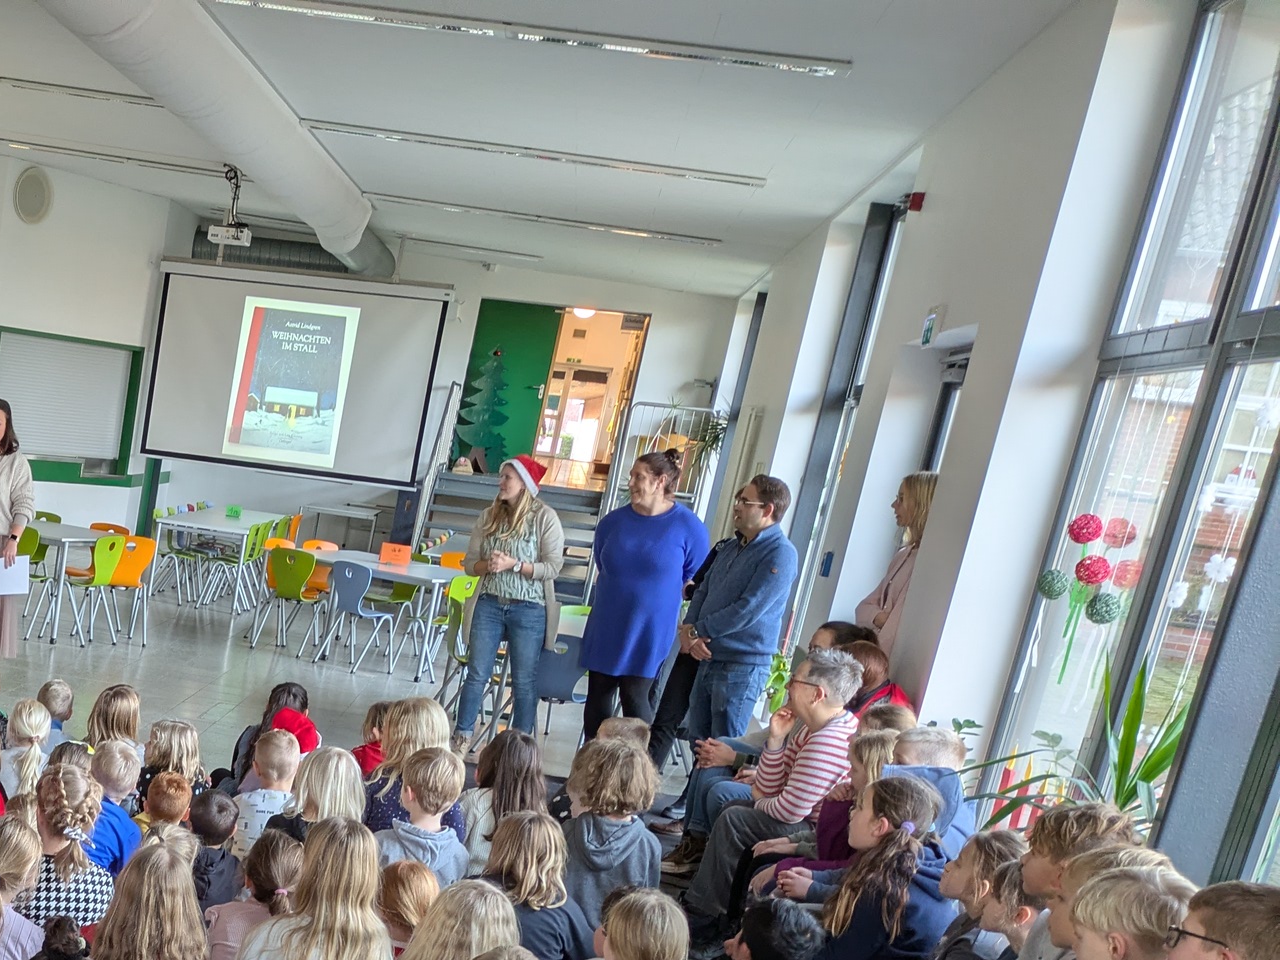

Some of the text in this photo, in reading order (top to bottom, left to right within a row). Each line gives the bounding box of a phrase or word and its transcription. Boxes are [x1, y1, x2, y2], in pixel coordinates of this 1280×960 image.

[271, 330, 332, 345] WEIHNACHTEN
[281, 341, 318, 354] IM STALL
